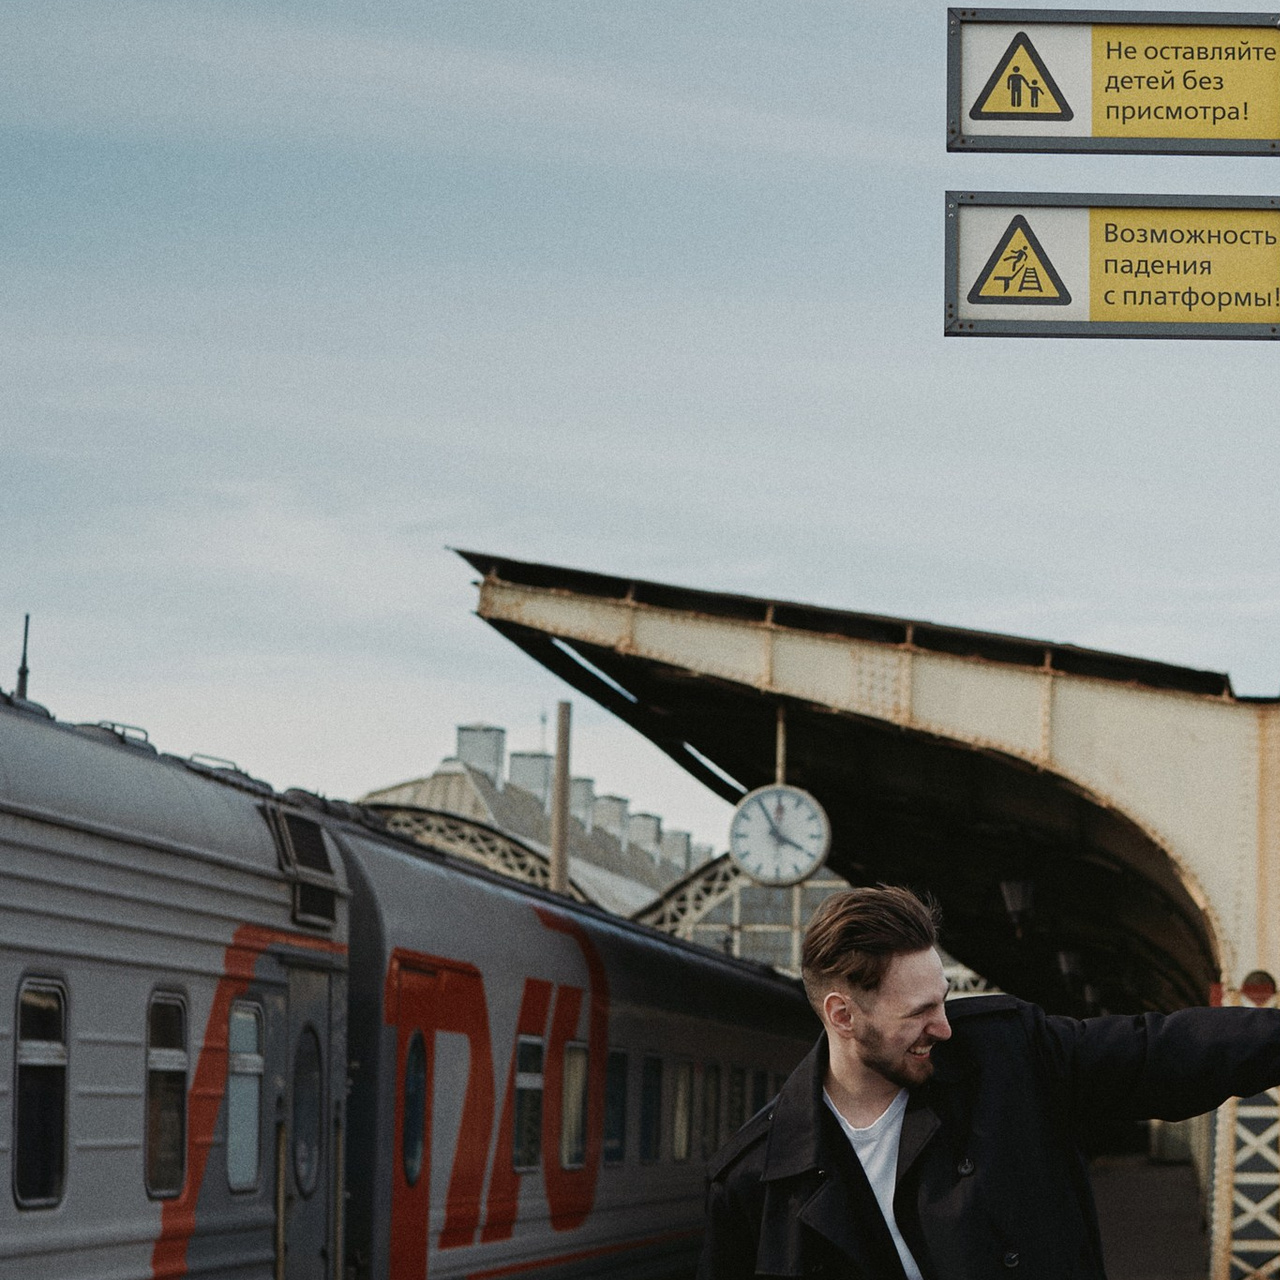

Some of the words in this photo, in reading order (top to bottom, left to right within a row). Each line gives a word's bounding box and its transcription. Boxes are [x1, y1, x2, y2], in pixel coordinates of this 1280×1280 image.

[1105, 40, 1138, 61] Не
[1143, 40, 1278, 62] оставляйте
[1103, 68, 1176, 93] детей
[1182, 68, 1225, 91] без
[1105, 101, 1249, 126] присмотра!
[1103, 221, 1278, 246] Возможность
[1103, 258, 1212, 279] падения
[1104, 289, 1116, 306] с
[1122, 286, 1280, 312] платформы!
